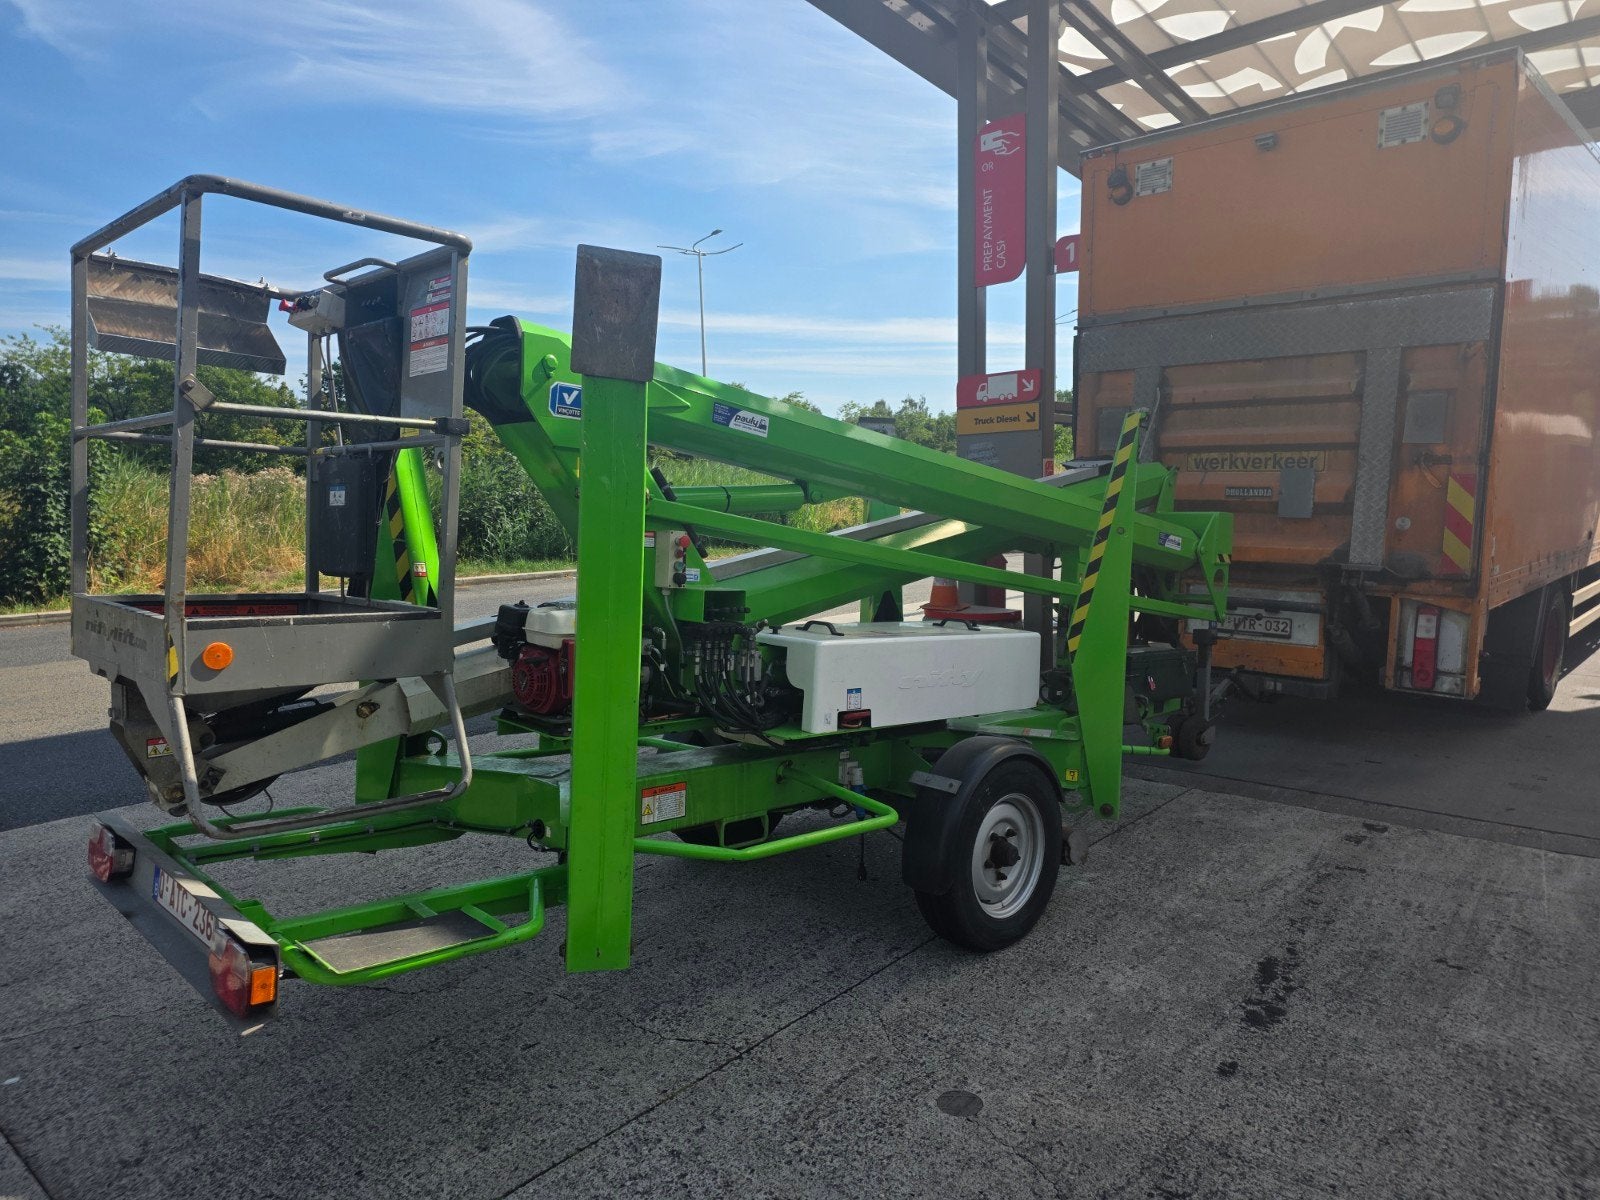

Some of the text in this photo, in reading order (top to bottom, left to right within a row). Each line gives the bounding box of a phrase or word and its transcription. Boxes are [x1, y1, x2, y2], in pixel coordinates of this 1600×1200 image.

[981, 161, 994, 172] OR
[983, 188, 993, 272] PREPAYMENT
[1065, 241, 1075, 263] 1
[974, 414, 1020, 425] Truck Diesel
[1193, 453, 1318, 470] werkverkeer
[1225, 487, 1272, 497] DHOLLANDIA
